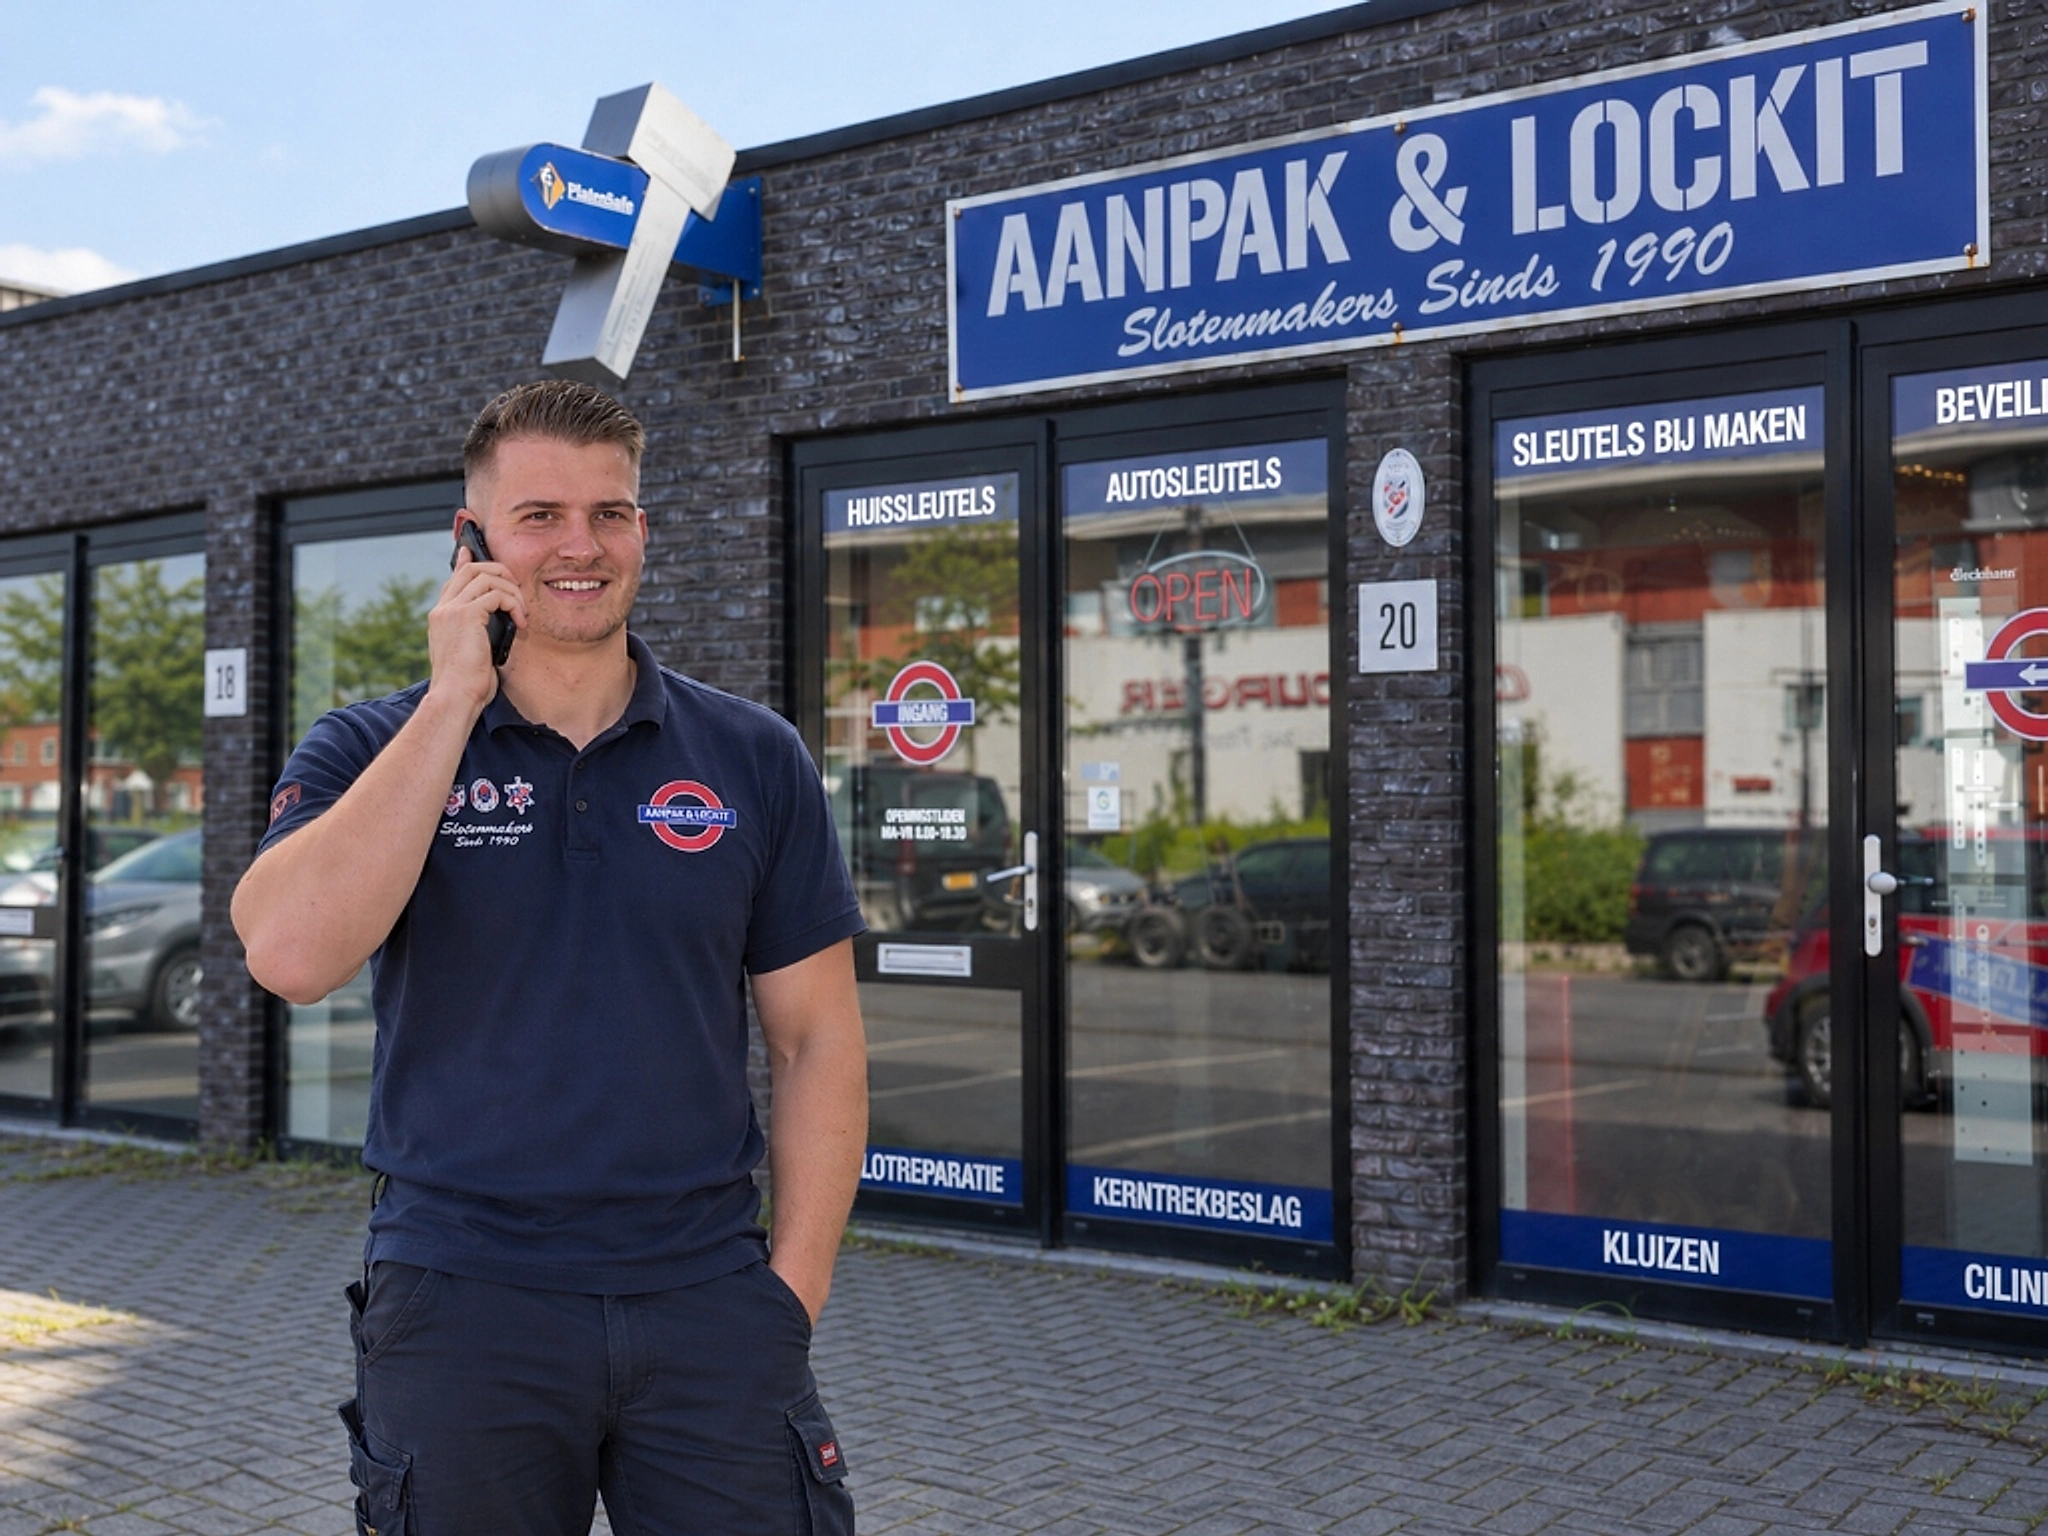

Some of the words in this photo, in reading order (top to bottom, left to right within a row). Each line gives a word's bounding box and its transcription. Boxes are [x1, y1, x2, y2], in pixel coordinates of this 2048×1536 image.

[986, 150, 1351, 318] AANPAK
[1389, 132, 1469, 253] &
[1510, 39, 1929, 236] LOCKIT
[1117, 280, 1398, 358] Slotenmakers
[1418, 253, 1560, 316] Sinds
[1590, 221, 1734, 293] 1990
[1512, 421, 1646, 467] SLEUTELS
[1653, 416, 1695, 454] BIJ
[1704, 405, 1806, 450] MAKEN
[1105, 456, 1282, 503] AUTOSLEUTELS
[847, 485, 996, 527] HUISSLEUTELS
[1130, 567, 1253, 623] OPEN
[1380, 601, 1416, 651] 20
[216, 665, 235, 700] 18
[897, 702, 949, 723] INGANG
[861, 1152, 1005, 1194] LOTREPARATIE
[1093, 1175, 1302, 1228] KERNTREKBESLAG
[1603, 1229, 1720, 1276] KLUIZEN
